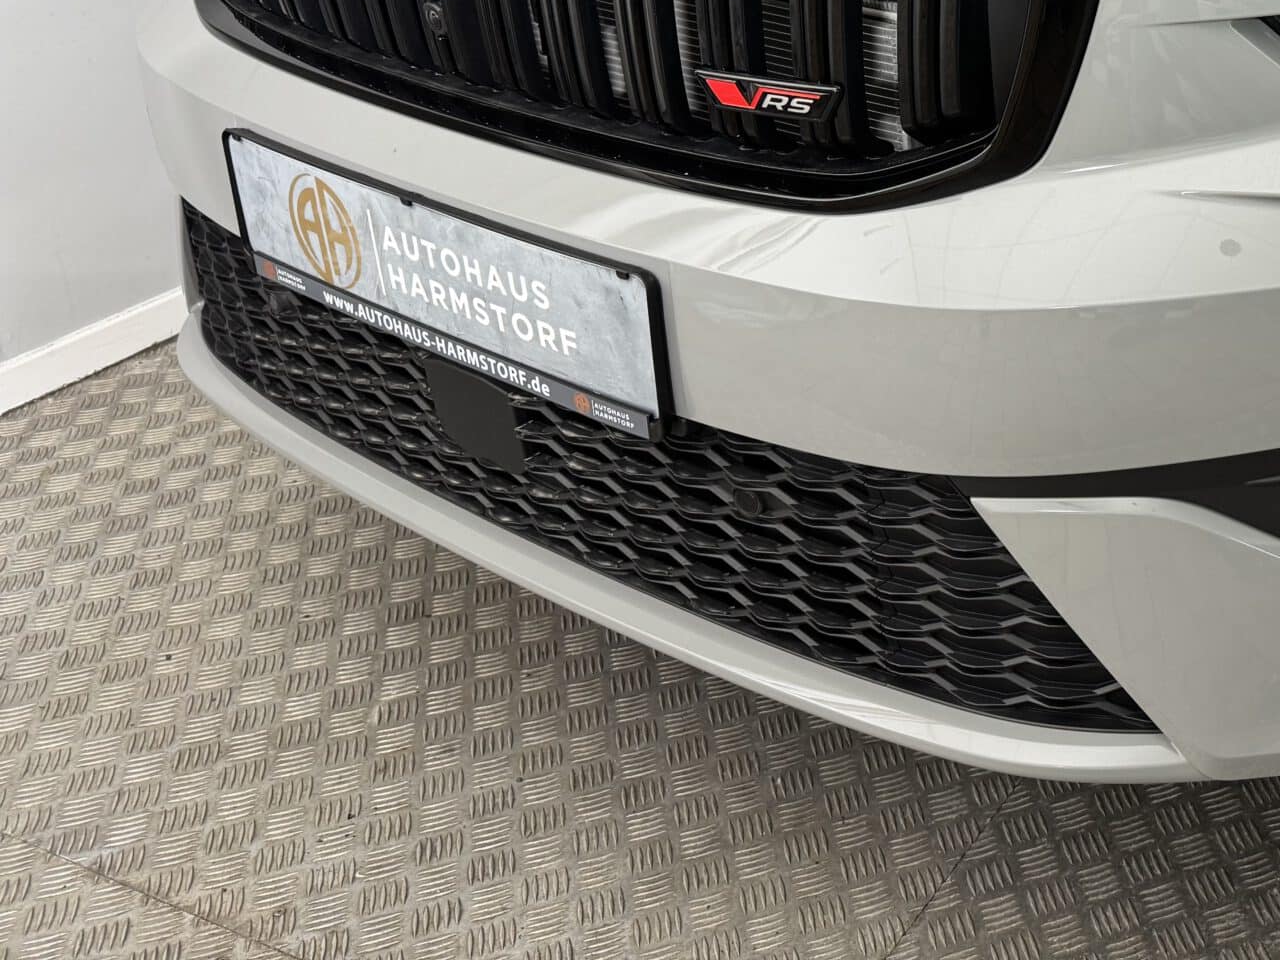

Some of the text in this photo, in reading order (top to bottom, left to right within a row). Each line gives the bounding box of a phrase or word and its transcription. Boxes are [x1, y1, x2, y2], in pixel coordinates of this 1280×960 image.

[382, 225, 550, 310] AUTOHAUS
[388, 263, 577, 357] HARMSTORF
[323, 290, 551, 397] www.AUTOHAUS-HARMSTORF.de
[594, 402, 630, 421] AUTOHAUS
[595, 410, 635, 430] HARMSTORF
